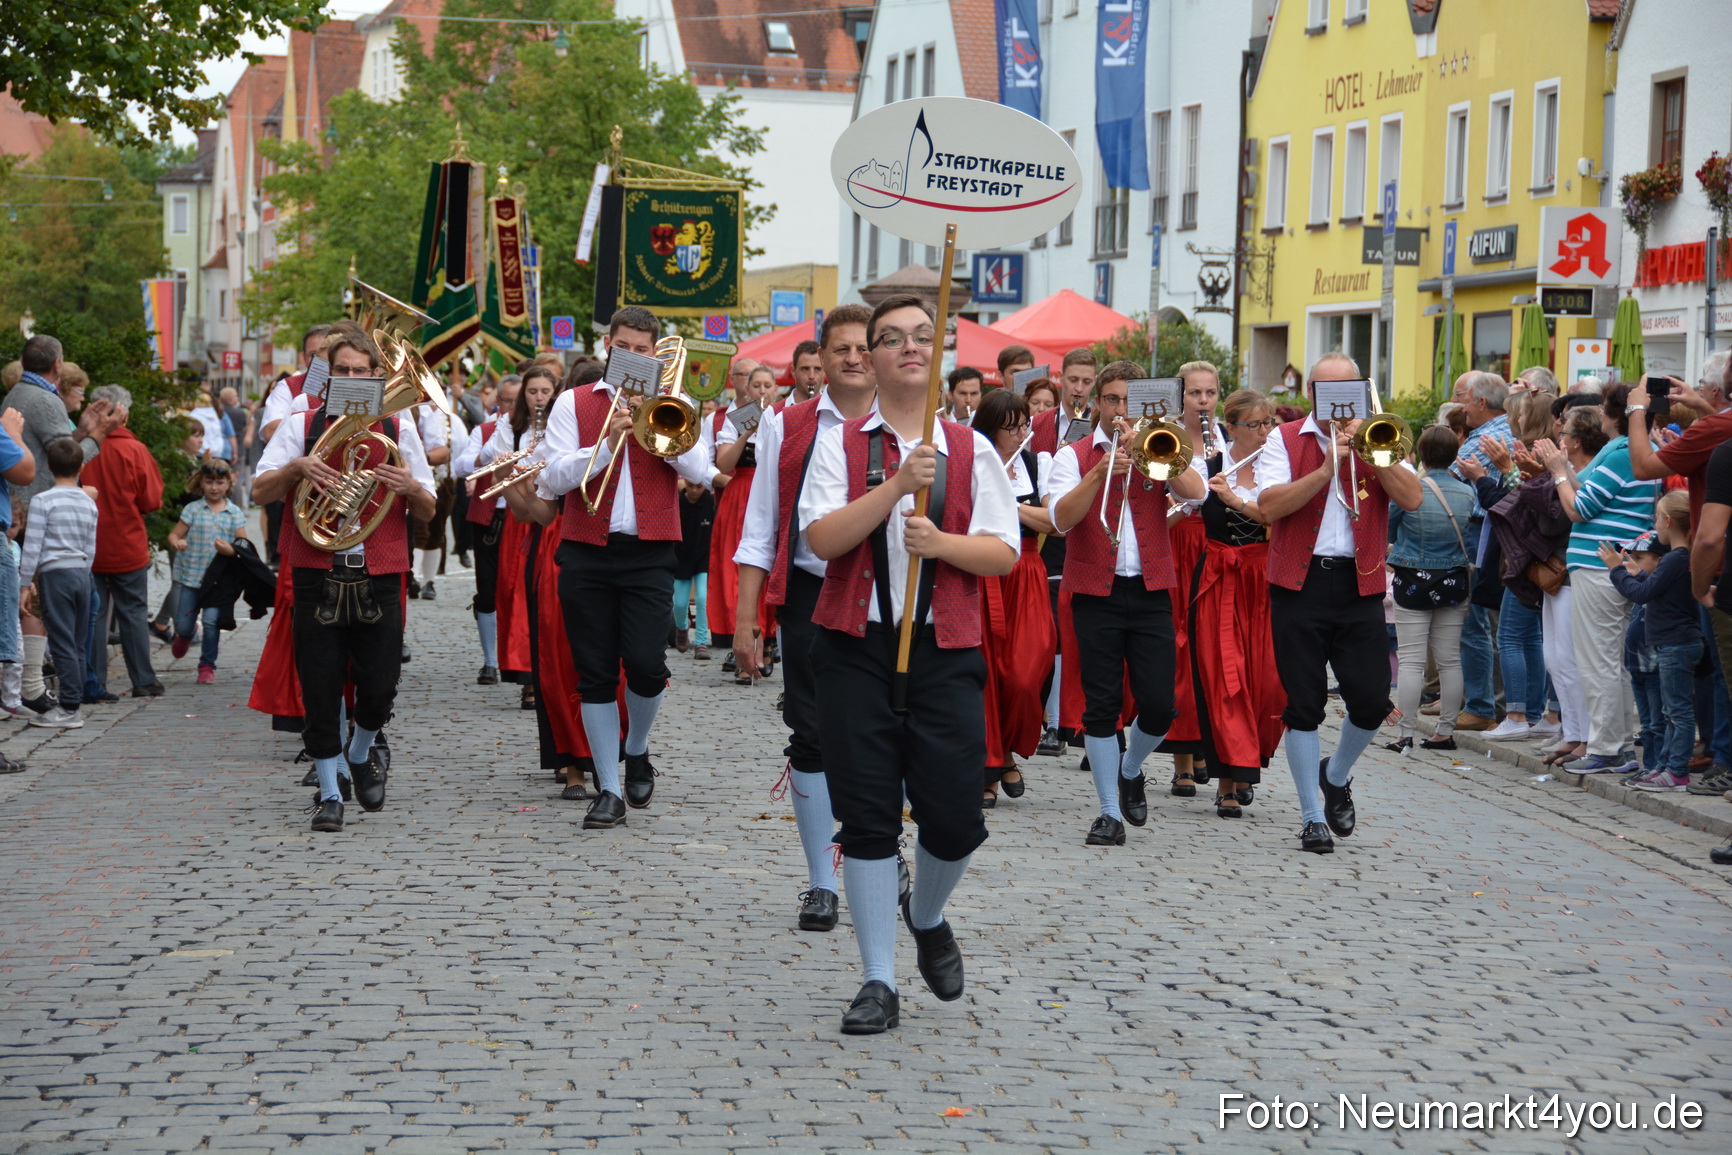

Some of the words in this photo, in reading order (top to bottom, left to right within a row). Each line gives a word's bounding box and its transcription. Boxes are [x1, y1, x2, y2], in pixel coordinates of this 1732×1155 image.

[1102, 0, 1132, 66] K&L
[1325, 71, 1365, 114] HOTEL
[1376, 64, 1423, 100] Lehmeier
[934, 152, 1066, 181] STADTKAPELLE
[926, 173, 1024, 198] FREYSTADT
[1366, 249, 1418, 261] TAUN
[1445, 228, 1454, 274] P
[1466, 230, 1507, 257] TAIFUN
[1313, 268, 1371, 296] Restaurant
[1654, 315, 1680, 329] APOTHEKE
